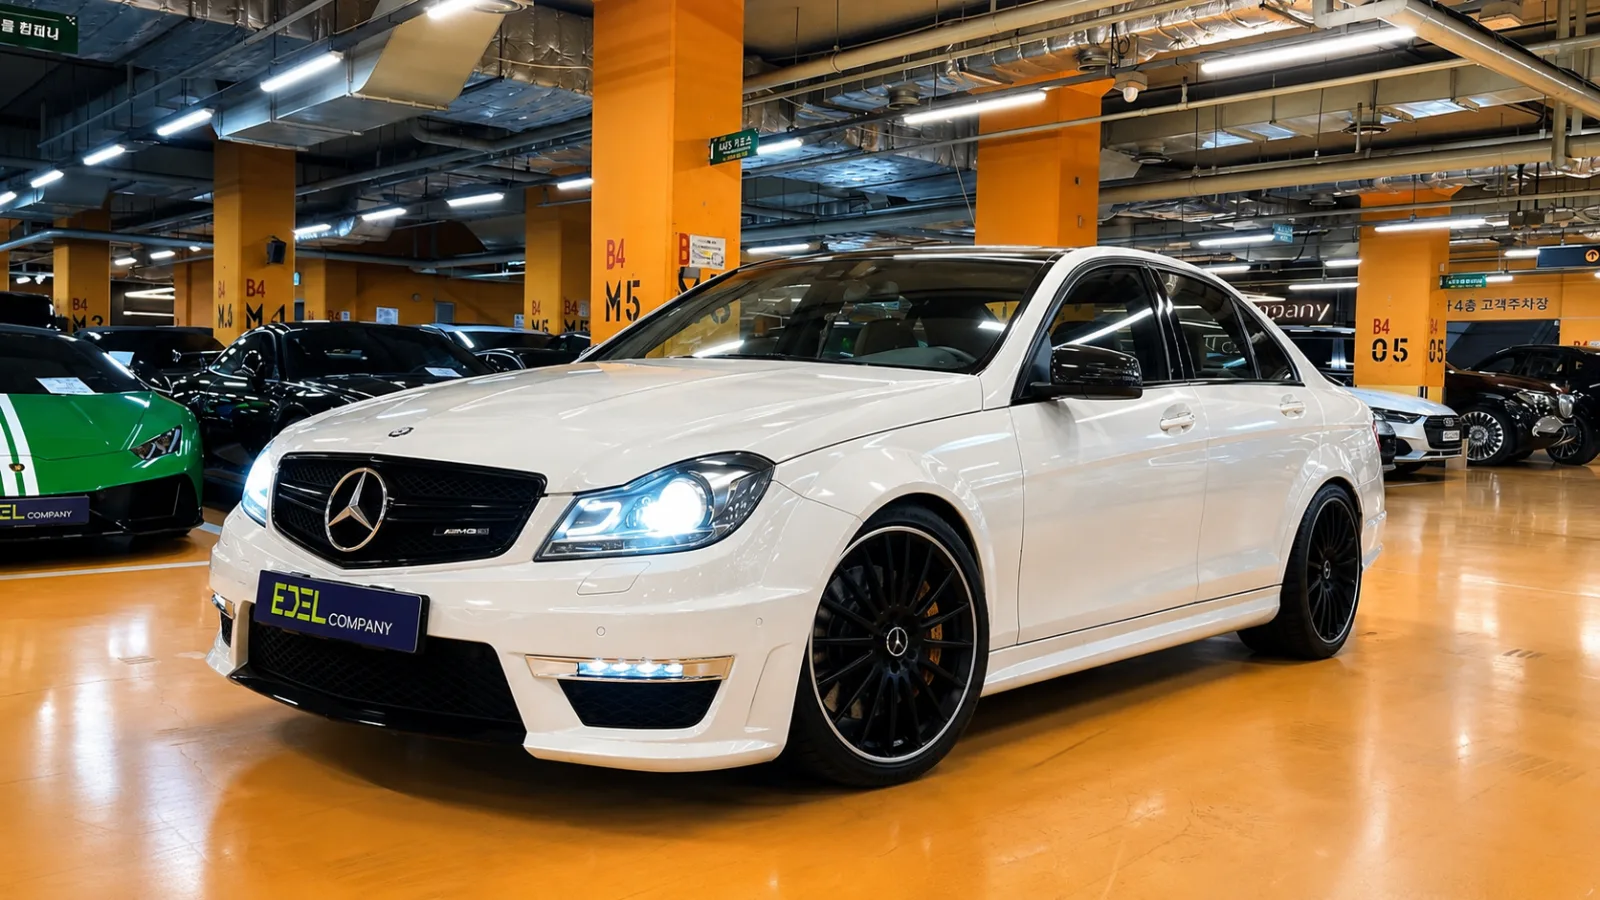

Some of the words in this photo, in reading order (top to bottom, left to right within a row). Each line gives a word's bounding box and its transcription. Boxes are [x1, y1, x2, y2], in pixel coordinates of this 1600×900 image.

[607, 238, 625, 270] B4
[679, 233, 690, 265] B
[246, 278, 266, 298] B4
[72, 298, 88, 311] B4
[563, 299, 579, 316] B4
[605, 280, 640, 322] M5
[1447, 299, 1476, 312] 4층
[1481, 297, 1549, 311] 고객주차장
[1373, 318, 1390, 335] B4
[27, 510, 72, 520] COMPANY
[271, 582, 327, 625] EDEL
[328, 612, 393, 636] COMPANY
